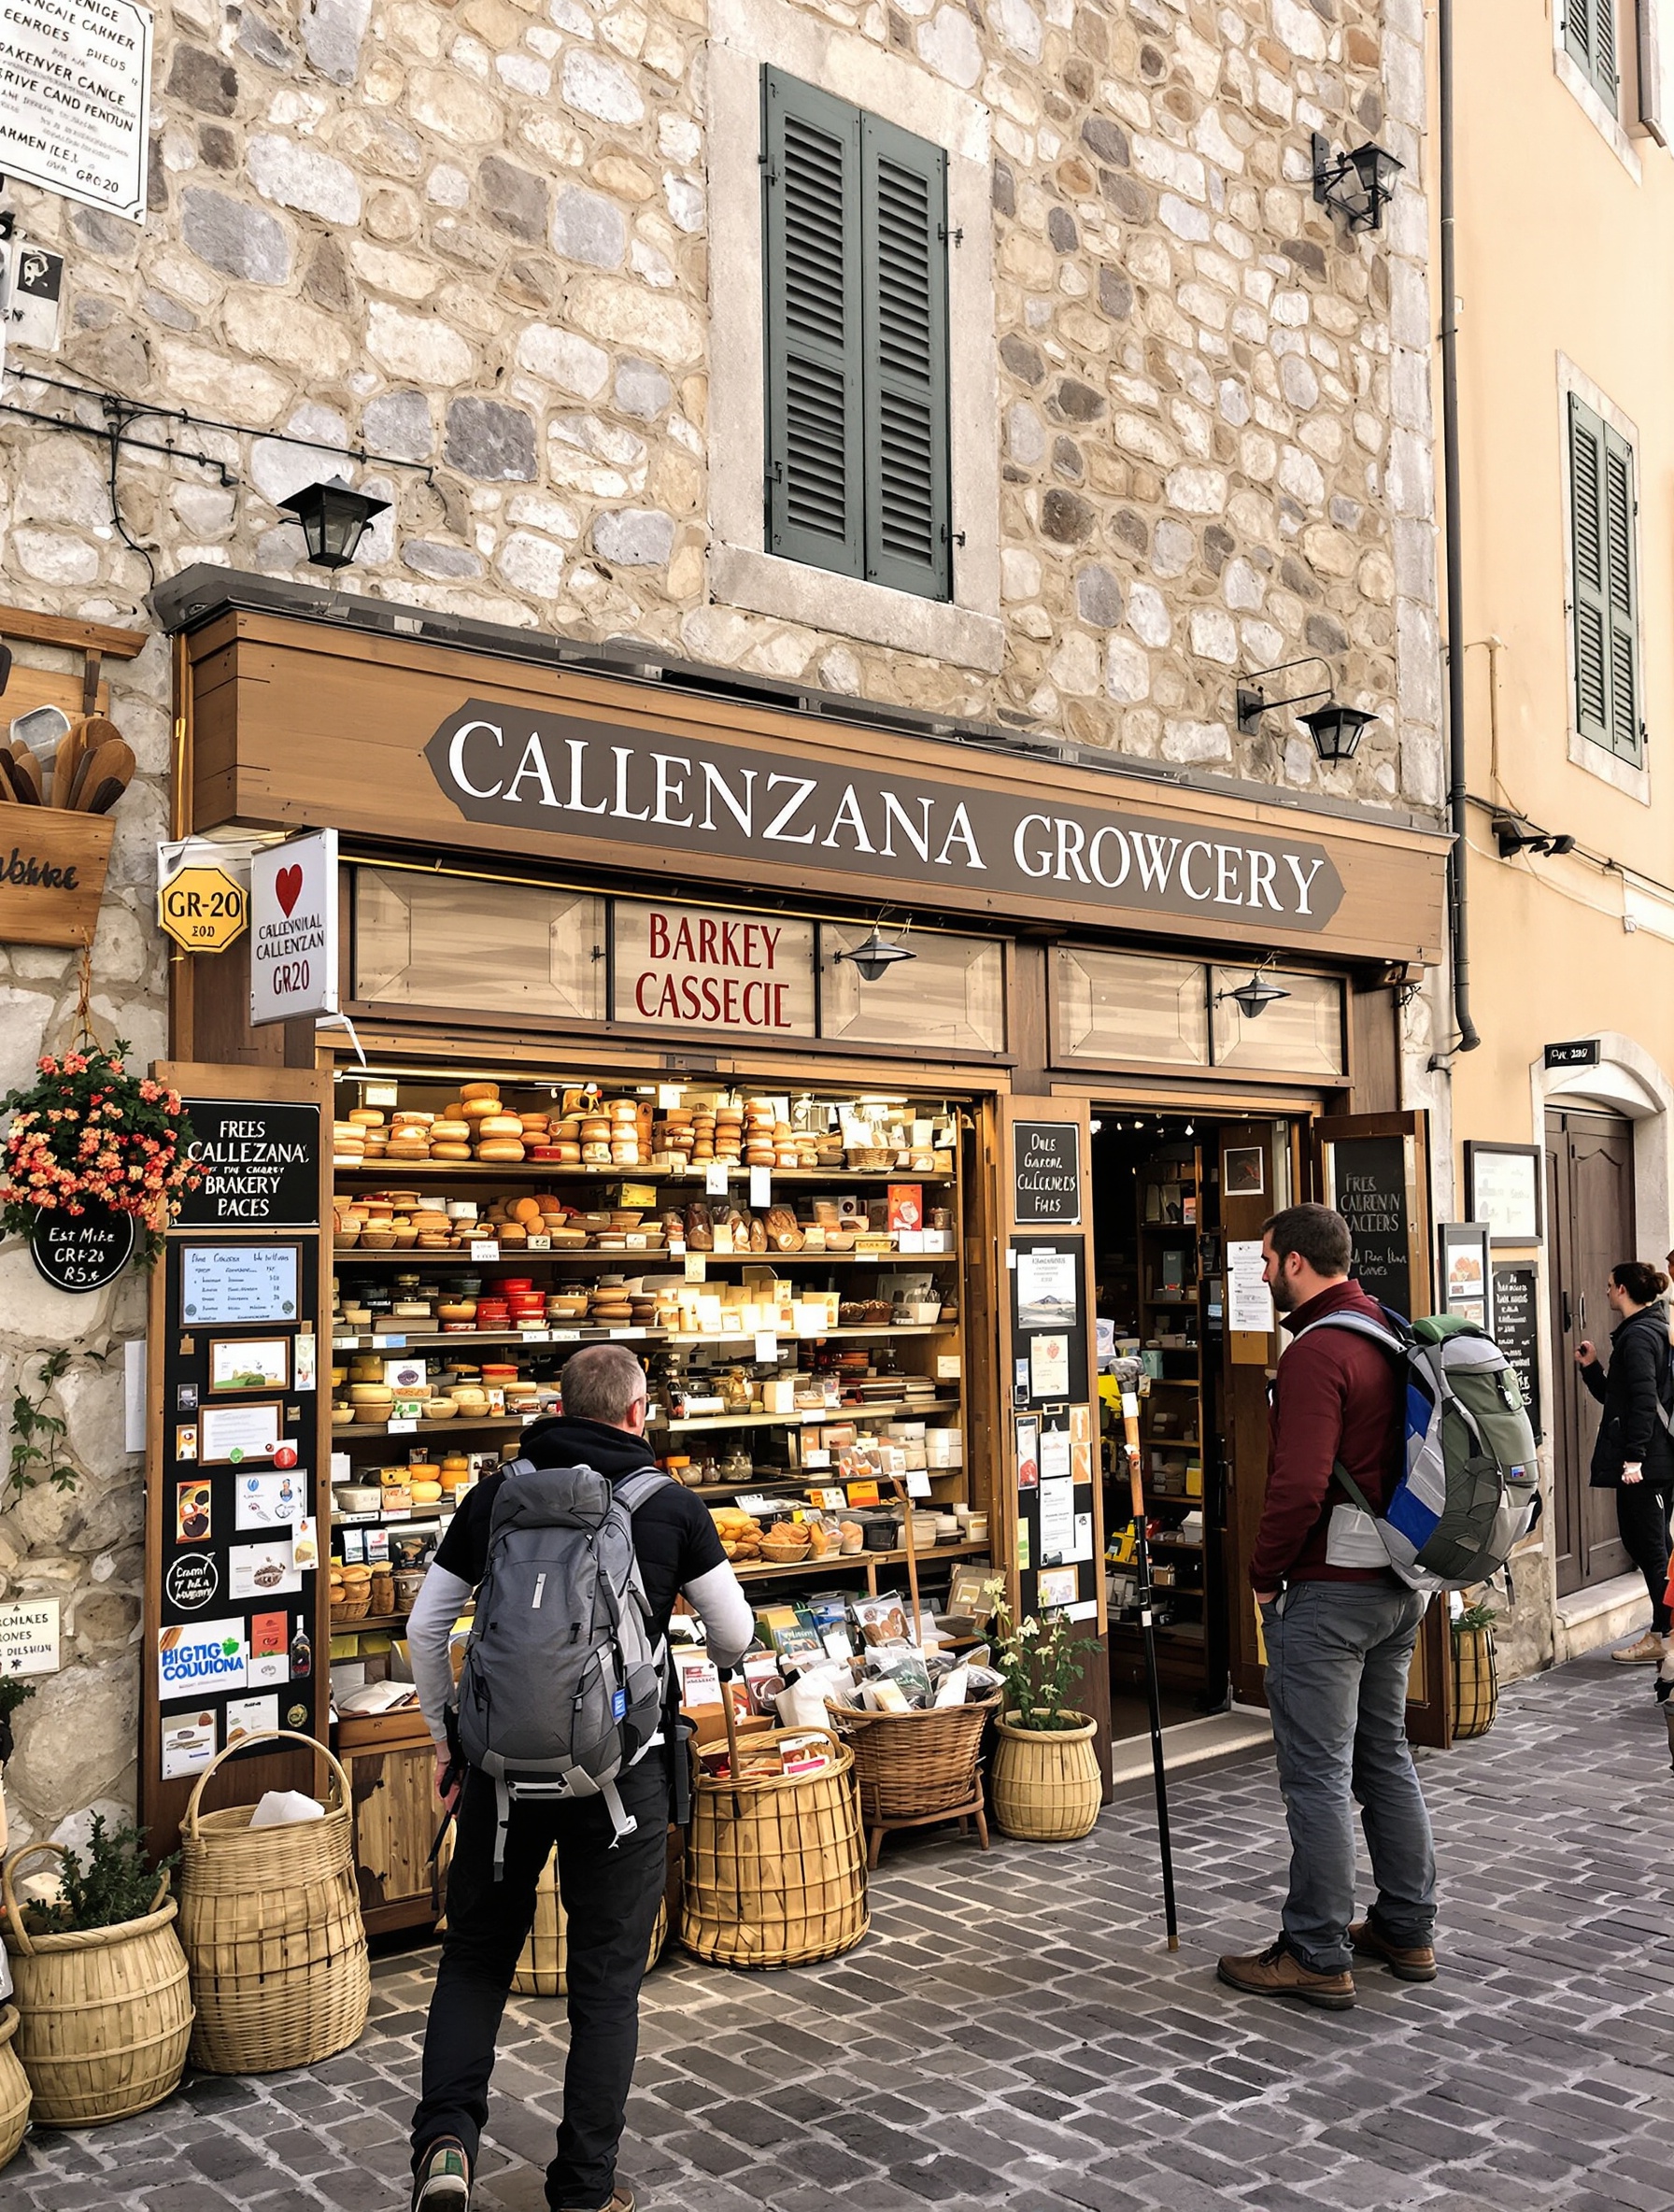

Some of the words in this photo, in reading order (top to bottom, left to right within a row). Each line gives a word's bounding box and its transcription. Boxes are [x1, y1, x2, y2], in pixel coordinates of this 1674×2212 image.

[448, 720, 987, 870] CALLENZANA
[1013, 814, 1325, 915] GROWCERY
[167, 890, 241, 918] GR-20
[256, 930, 324, 960] CALLENZAN
[649, 913, 782, 970] BARKEY
[273, 959, 310, 996] GR20
[220, 1120, 266, 1139] FREES
[205, 1175, 281, 1195] BRAKERY
